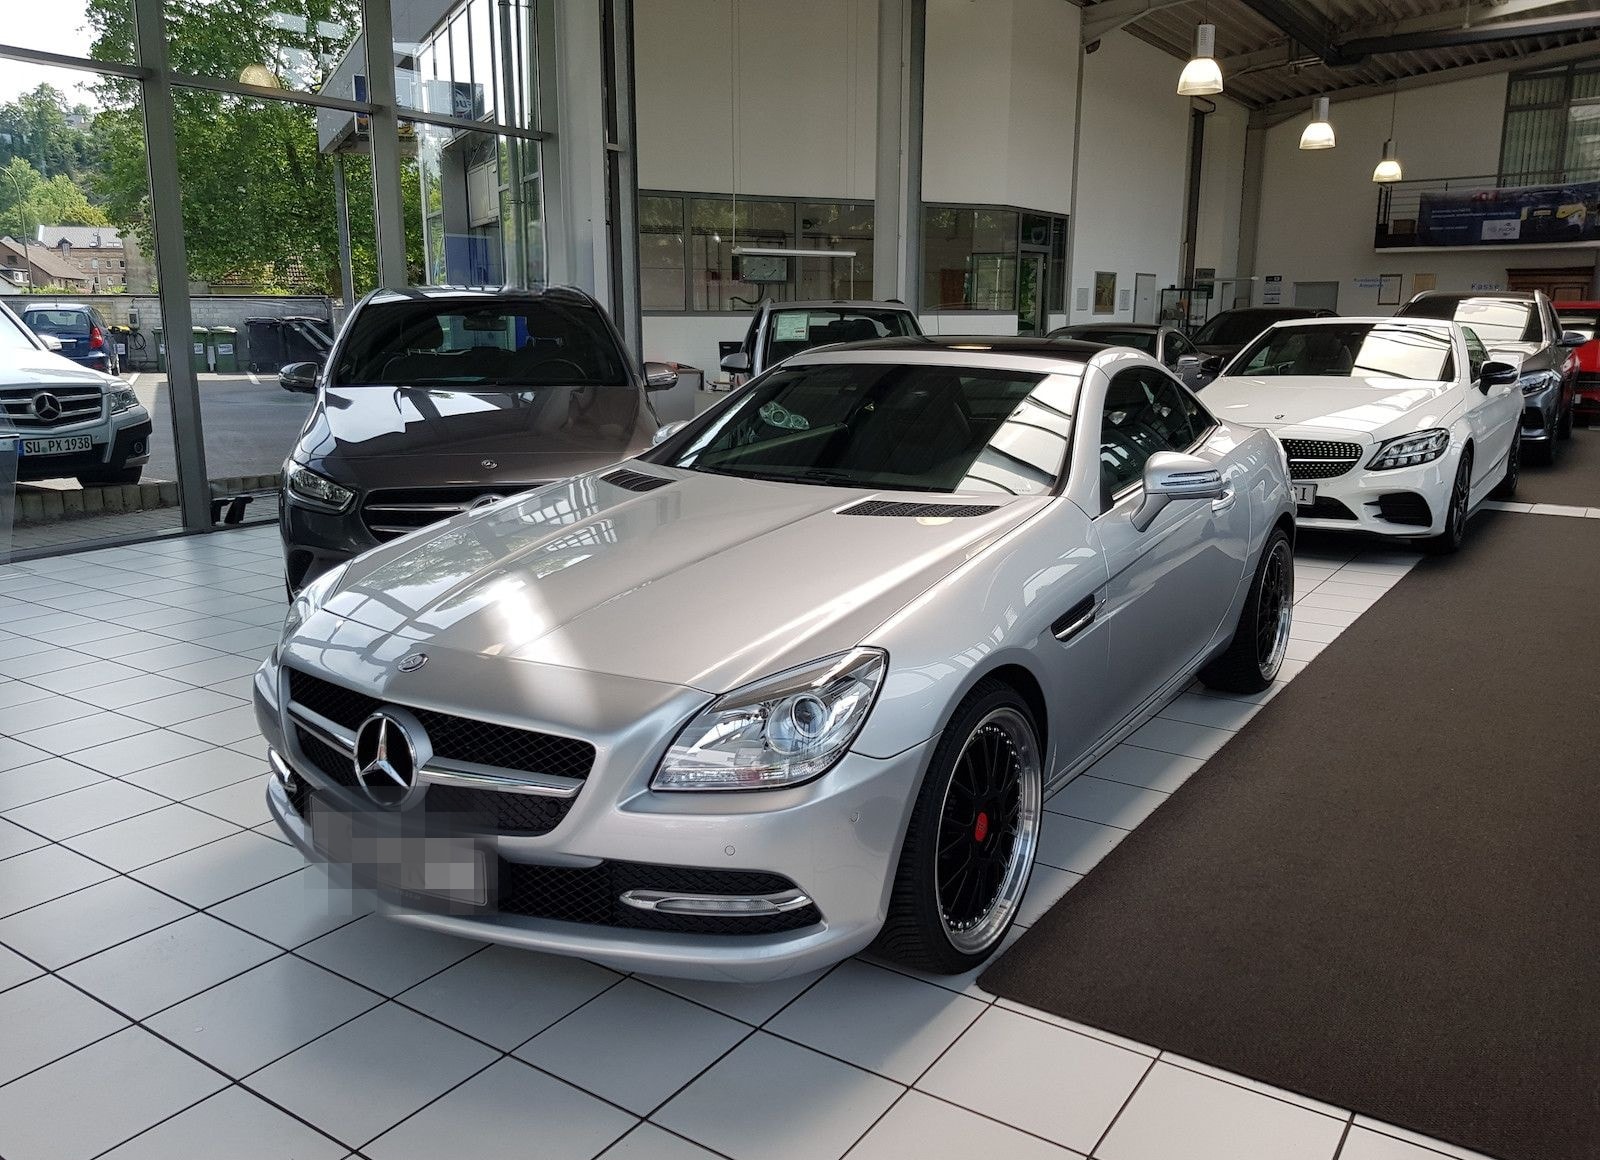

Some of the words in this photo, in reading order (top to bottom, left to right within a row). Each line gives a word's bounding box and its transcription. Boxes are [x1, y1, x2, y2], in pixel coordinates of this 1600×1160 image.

[25, 441, 40, 453] SU
[47, 440, 63, 452] PX
[64, 437, 90, 451] 1938
